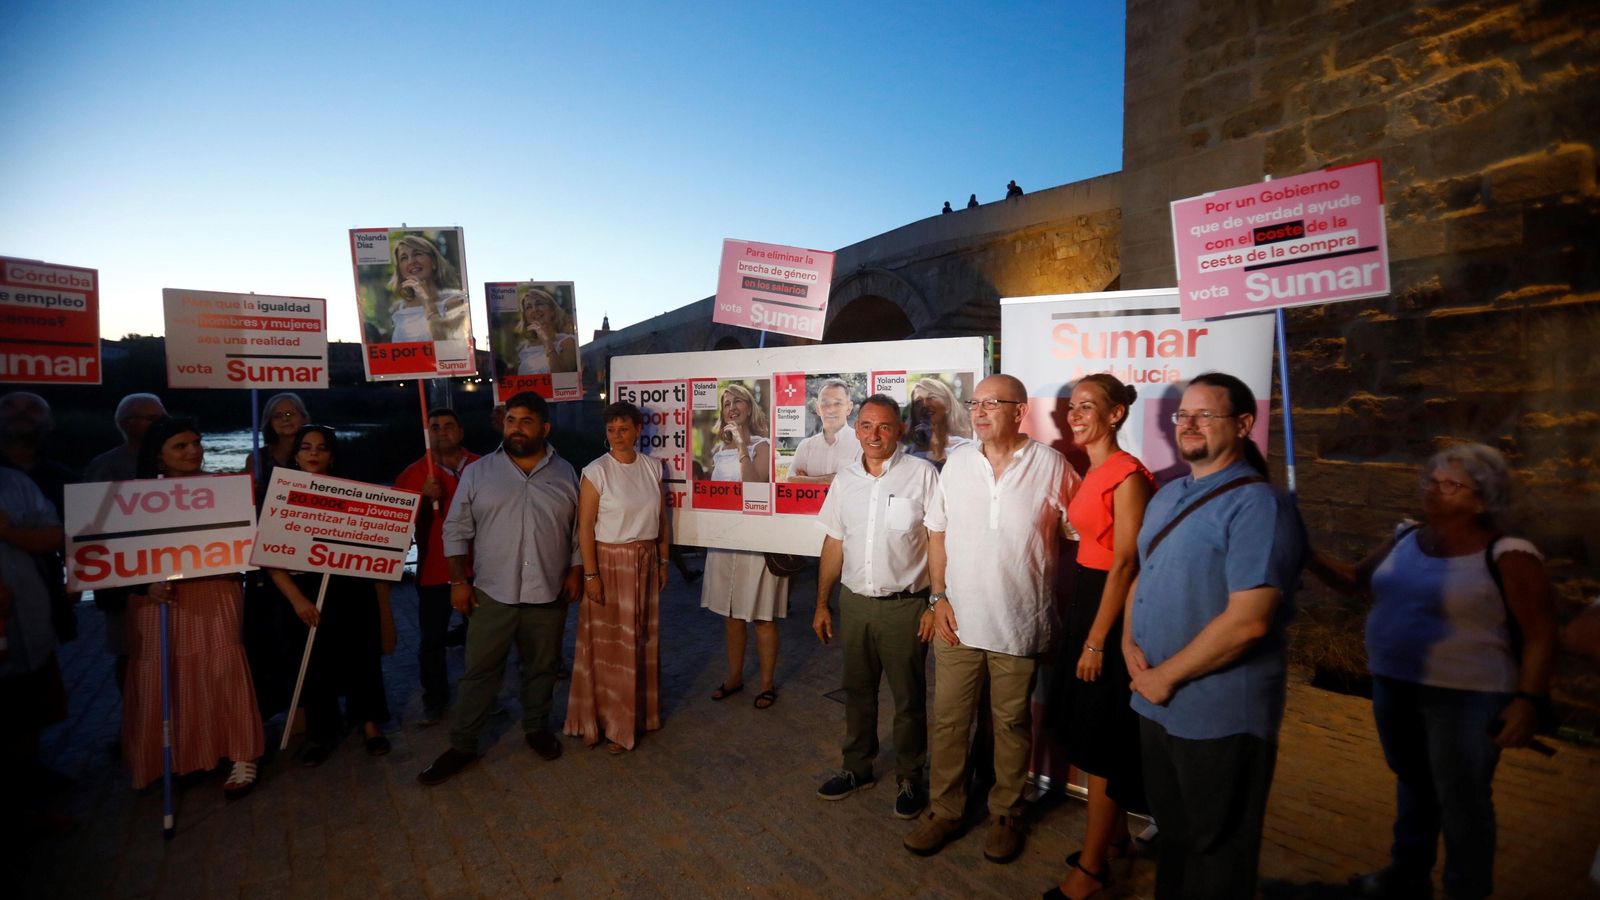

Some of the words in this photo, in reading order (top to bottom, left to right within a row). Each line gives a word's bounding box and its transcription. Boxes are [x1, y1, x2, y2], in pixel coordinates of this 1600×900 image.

[1205, 201, 1231, 214] Por
[1235, 197, 1255, 209] un
[1260, 178, 1340, 203] Gobierno
[1190, 222, 1220, 237] que
[1223, 216, 1243, 230] de
[1248, 205, 1304, 225] verdad
[1308, 194, 1361, 214] ayude
[356, 233, 387, 242] Yolanda
[1205, 238, 1234, 252] con
[1238, 231, 1251, 245] el
[1256, 224, 1303, 242] coste
[1306, 219, 1328, 233] de
[1332, 215, 1347, 228] la
[746, 247, 765, 258] Para
[767, 251, 803, 263] eliminar
[805, 255, 814, 265] la
[1200, 254, 1243, 270] cesta
[1247, 249, 1266, 262] de
[1271, 245, 1285, 258] la
[1289, 234, 1356, 255] compra
[10, 268, 91, 287] Córdoba
[738, 262, 769, 274] brecha
[771, 266, 782, 276] de
[784, 269, 817, 281] género
[757, 280, 770, 290] los
[771, 282, 807, 295] salarios
[1189, 285, 1229, 301] vota
[1245, 262, 1380, 302] Sumar
[15, 291, 84, 308] empleo
[215, 300, 241, 310] que
[244, 300, 254, 309] la
[257, 300, 311, 313] igualdad
[261, 320, 268, 329] y
[271, 319, 321, 331] mujeres
[720, 303, 742, 314] vota
[750, 302, 817, 332] Sumar
[223, 336, 247, 345] una
[251, 336, 300, 347] realidad
[1051, 323, 1208, 360] Sumar
[369, 345, 387, 359] Es
[391, 347, 418, 361] por
[422, 343, 433, 357] ti
[177, 362, 213, 375] vota
[226, 359, 323, 382] Sumar
[439, 361, 467, 370] Sumar
[1073, 364, 1182, 384] Alucía
[500, 377, 513, 389] Es
[518, 379, 538, 391] por
[543, 374, 552, 386] ti
[876, 376, 905, 384] Yolanda
[555, 389, 577, 397] Sumar
[617, 386, 636, 403] Es
[640, 389, 669, 407] por
[673, 384, 685, 402] ti
[673, 407, 685, 426] ti
[639, 434, 669, 452] por
[673, 430, 685, 448] ti
[673, 453, 684, 471] ti
[114, 484, 215, 516] vota
[277, 478, 291, 488] Por
[292, 481, 307, 489] una
[309, 480, 362, 498] herencia
[365, 492, 416, 507] universal
[694, 484, 706, 494] Es
[710, 486, 730, 497] por
[733, 484, 742, 496] ti
[777, 485, 792, 498] Es
[796, 488, 820, 501] por
[276, 493, 287, 501] de
[348, 506, 364, 514] para
[365, 504, 409, 519] jóvenes
[745, 503, 768, 511] Sumar
[270, 506, 277, 517] y
[280, 508, 344, 525] garantizar
[347, 517, 357, 527] la
[359, 518, 409, 534] igualdad
[285, 521, 301, 532] de
[304, 525, 389, 544] oportunidades
[74, 538, 252, 582] Sumar
[262, 543, 296, 555] vota
[307, 543, 401, 574] Sumar
